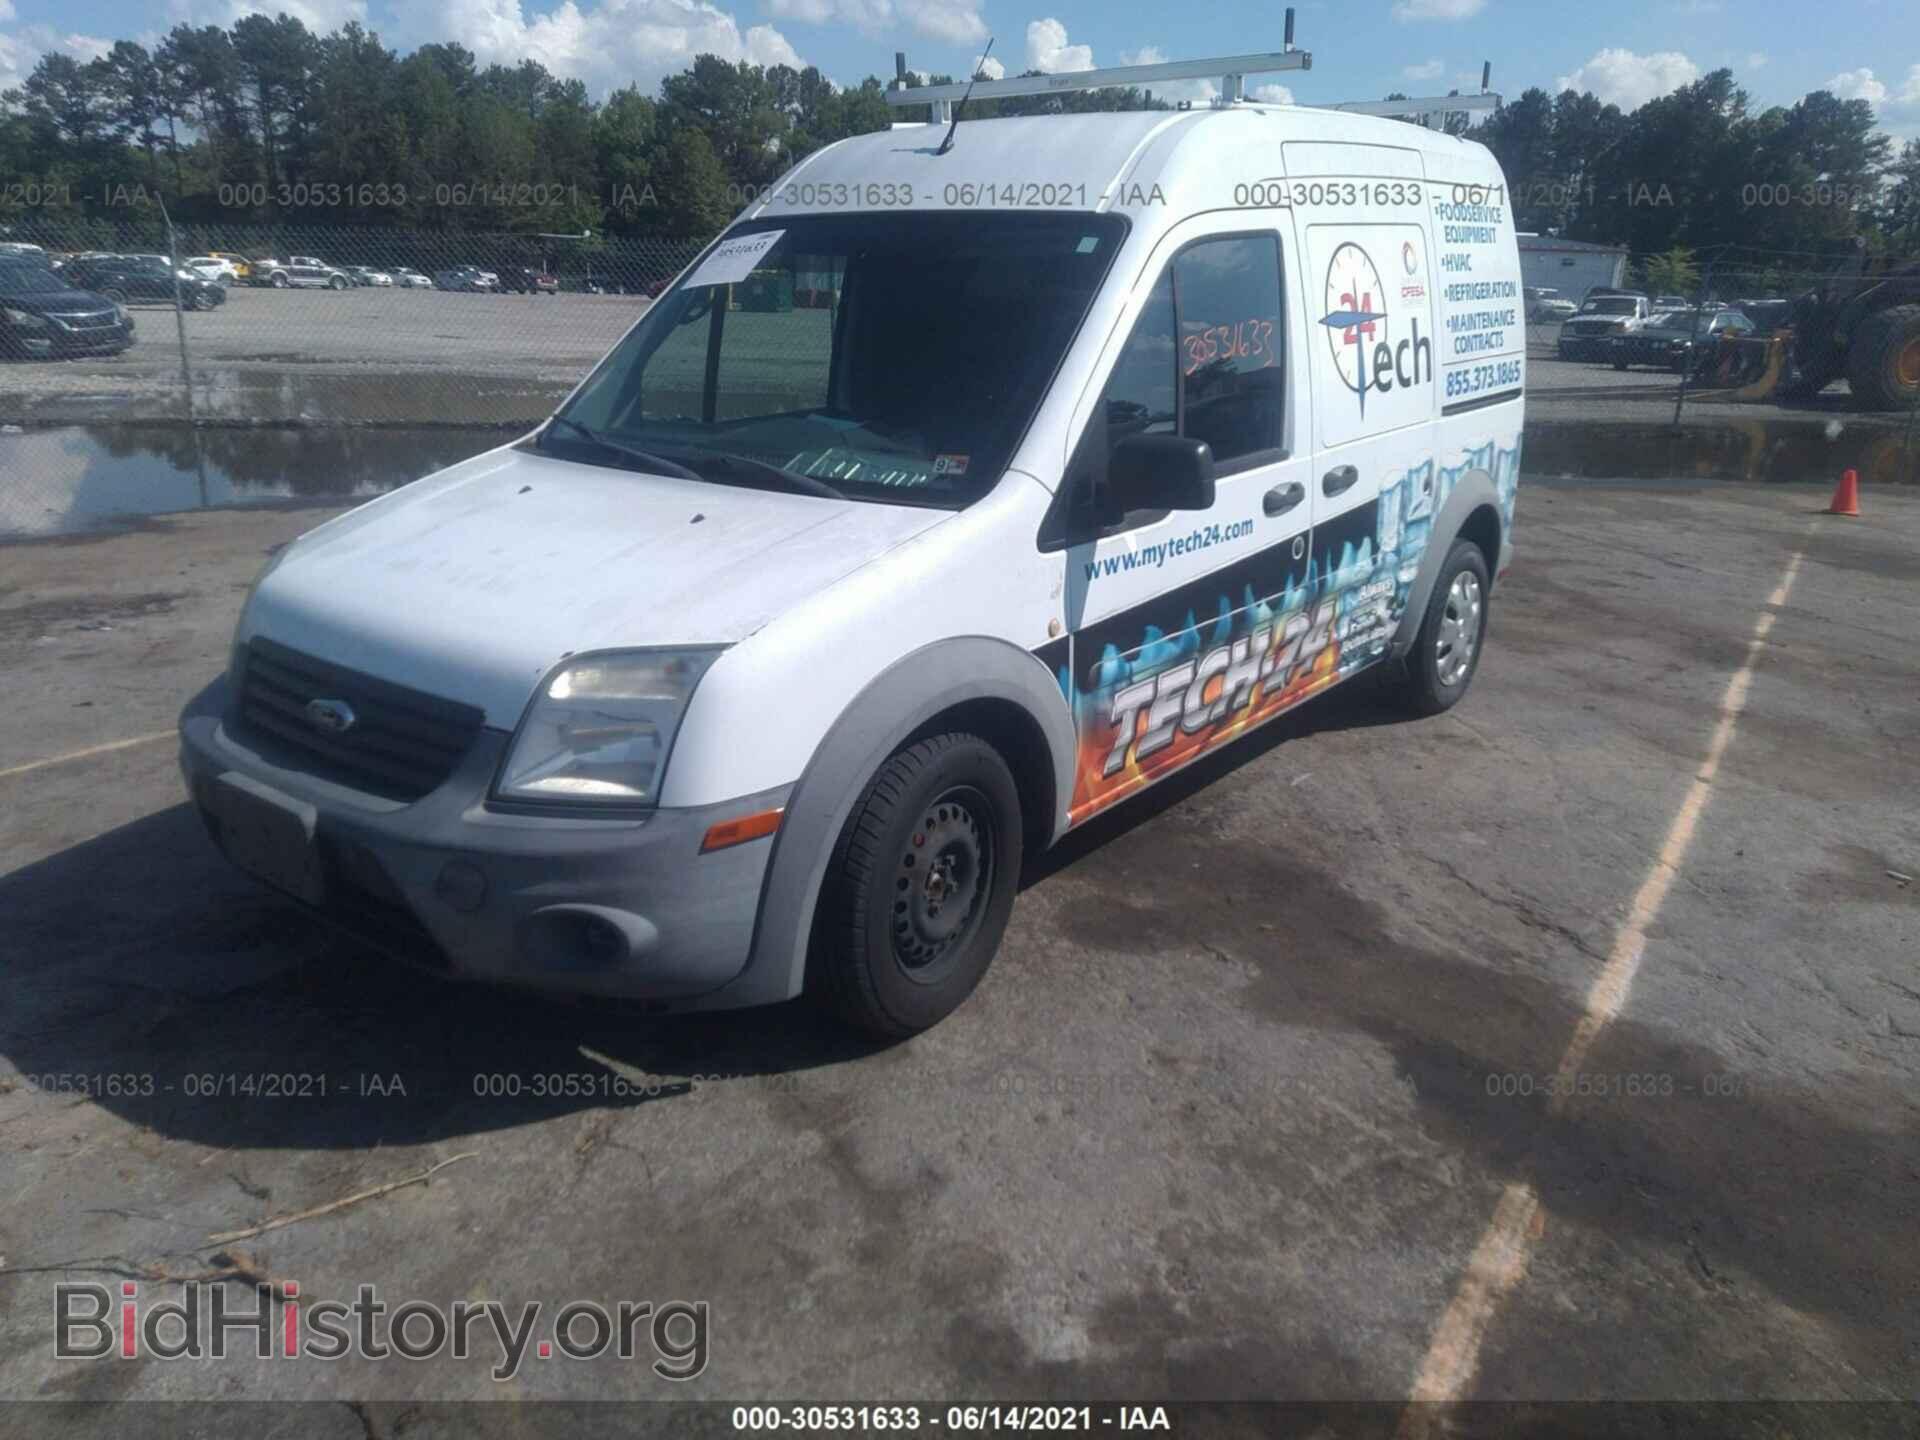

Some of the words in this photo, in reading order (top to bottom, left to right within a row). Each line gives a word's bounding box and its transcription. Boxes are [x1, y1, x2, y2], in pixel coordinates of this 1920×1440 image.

[1439, 204, 1502, 224] FOODSERVICE
[1444, 225, 1496, 244] EQUIPMENT
[1445, 254, 1472, 272] HVAC
[1448, 281, 1517, 302] REFRIGERATION
[1450, 309, 1515, 333] MAINTENANCE
[1455, 332, 1504, 354] CONTRACTS
[1446, 360, 1522, 397] 855.373.1865
[1085, 518, 1254, 582] www.mytech24.com
